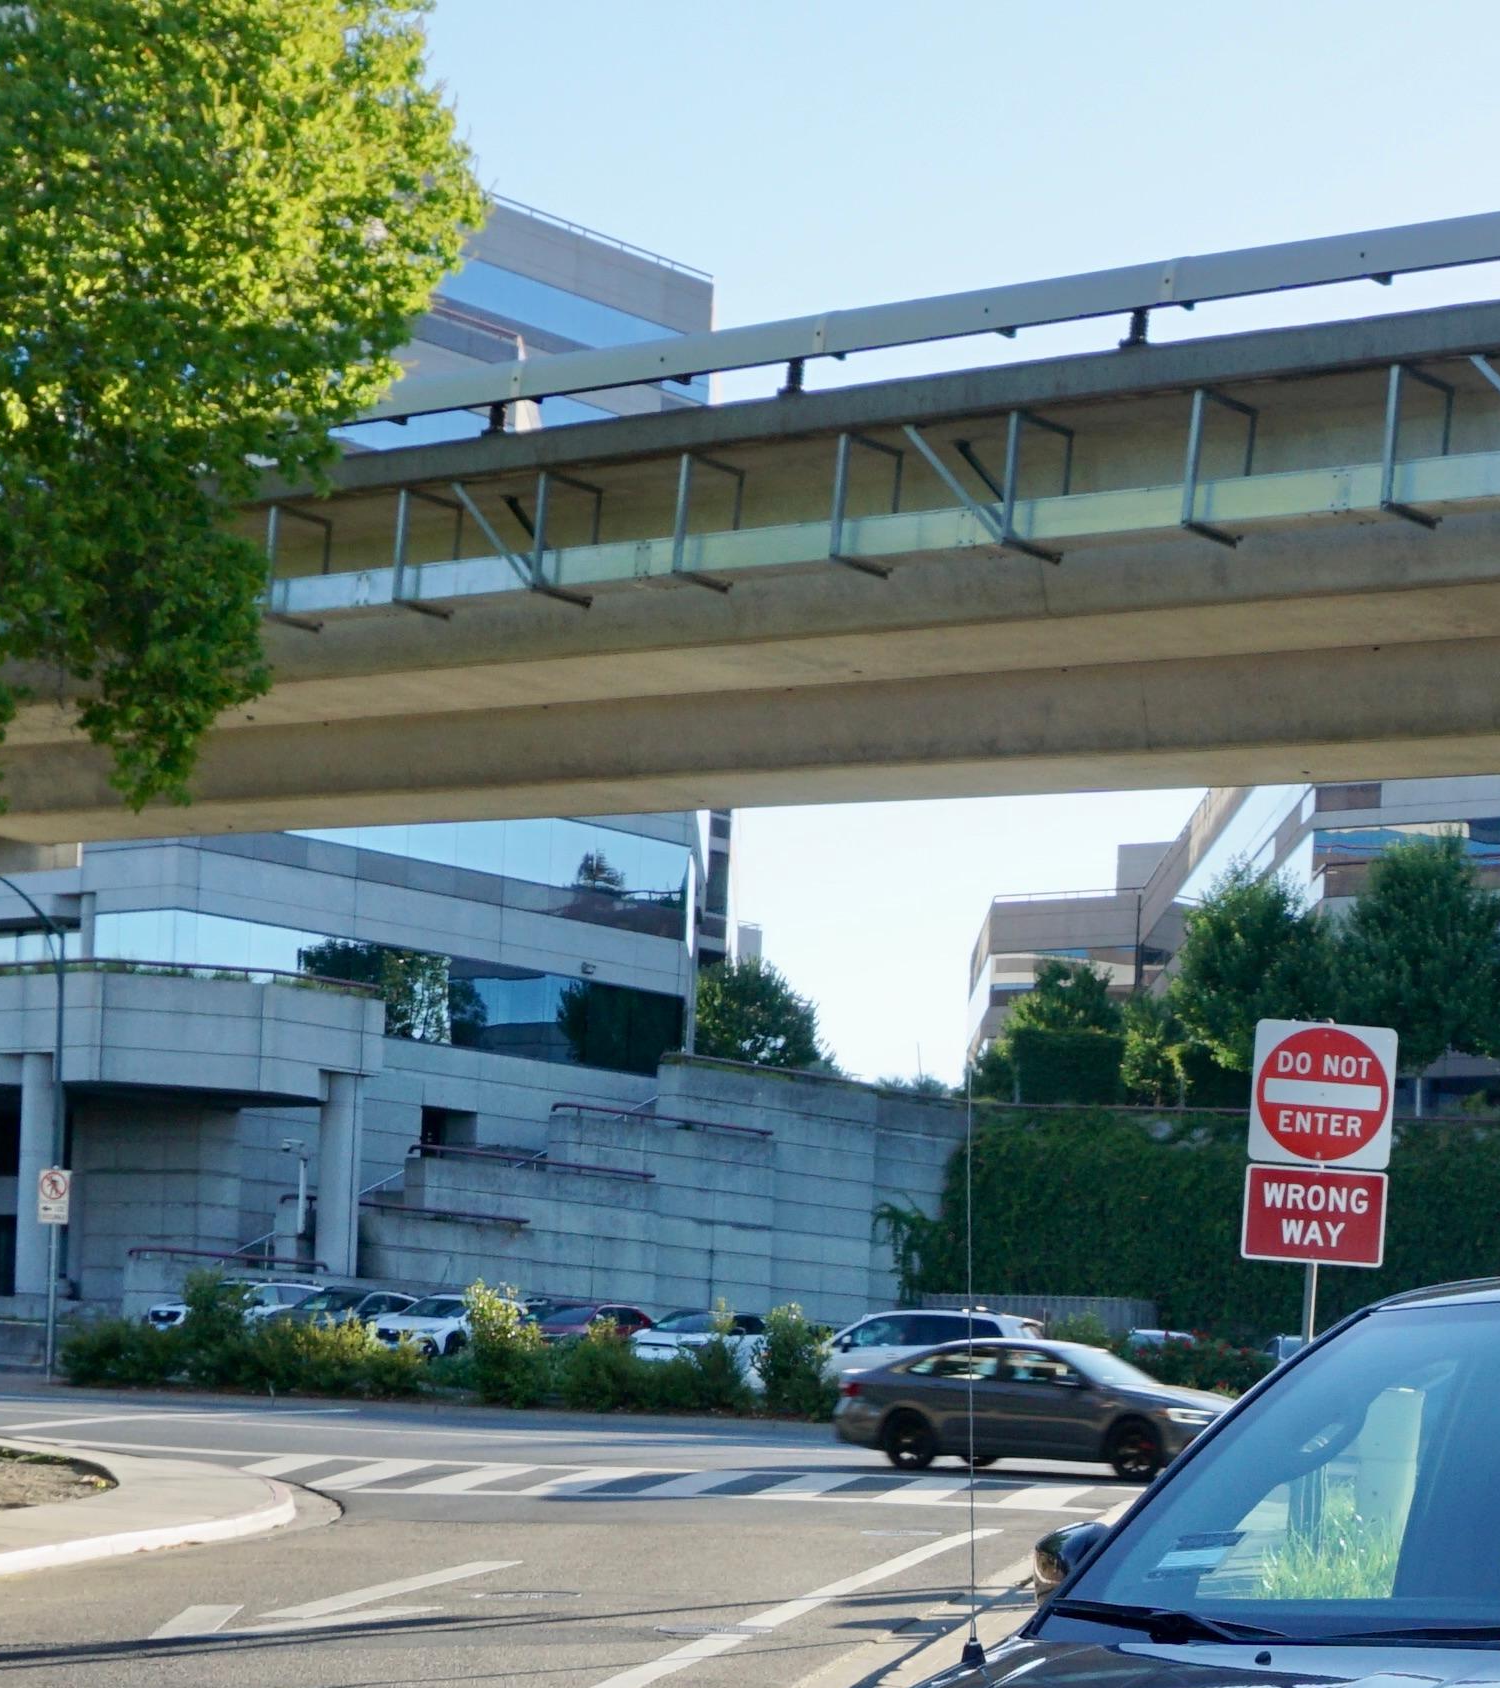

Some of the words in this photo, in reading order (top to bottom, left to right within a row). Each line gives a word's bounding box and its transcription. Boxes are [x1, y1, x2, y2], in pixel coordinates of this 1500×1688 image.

[1277, 1050, 1312, 1075] DO
[1322, 1053, 1373, 1079] NOT
[1278, 1109, 1362, 1138] ENTER
[1263, 1181, 1369, 1214] WRONG
[1281, 1218, 1346, 1248] WAY
